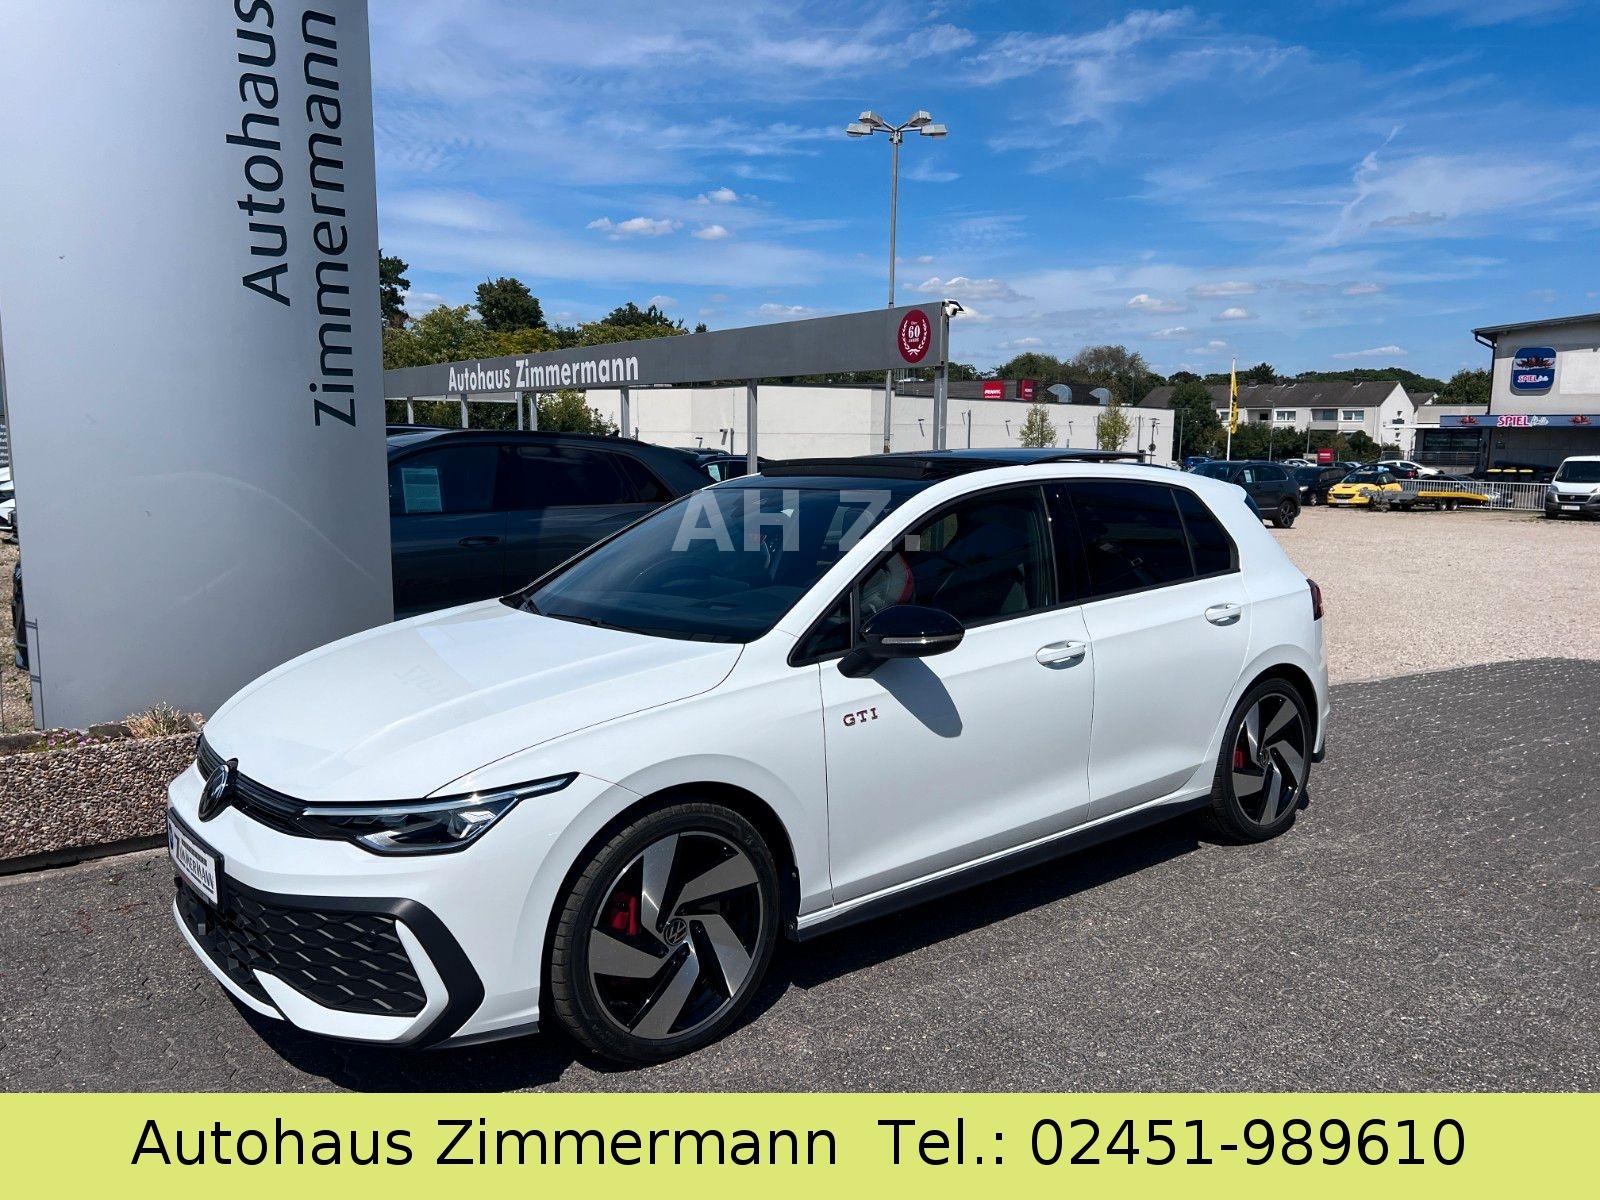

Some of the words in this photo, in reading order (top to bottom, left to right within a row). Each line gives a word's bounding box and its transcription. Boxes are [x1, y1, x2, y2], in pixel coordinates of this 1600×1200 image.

[226, 0, 291, 307] Autohaus
[302, 10, 357, 428] Zimmermann
[908, 325, 920, 339] 60
[449, 363, 511, 391] Autohaus
[515, 356, 639, 388] Zimmermann
[1517, 375, 1538, 383] SPIEL
[1497, 415, 1530, 427] SPIEL
[842, 707, 879, 727] GTI
